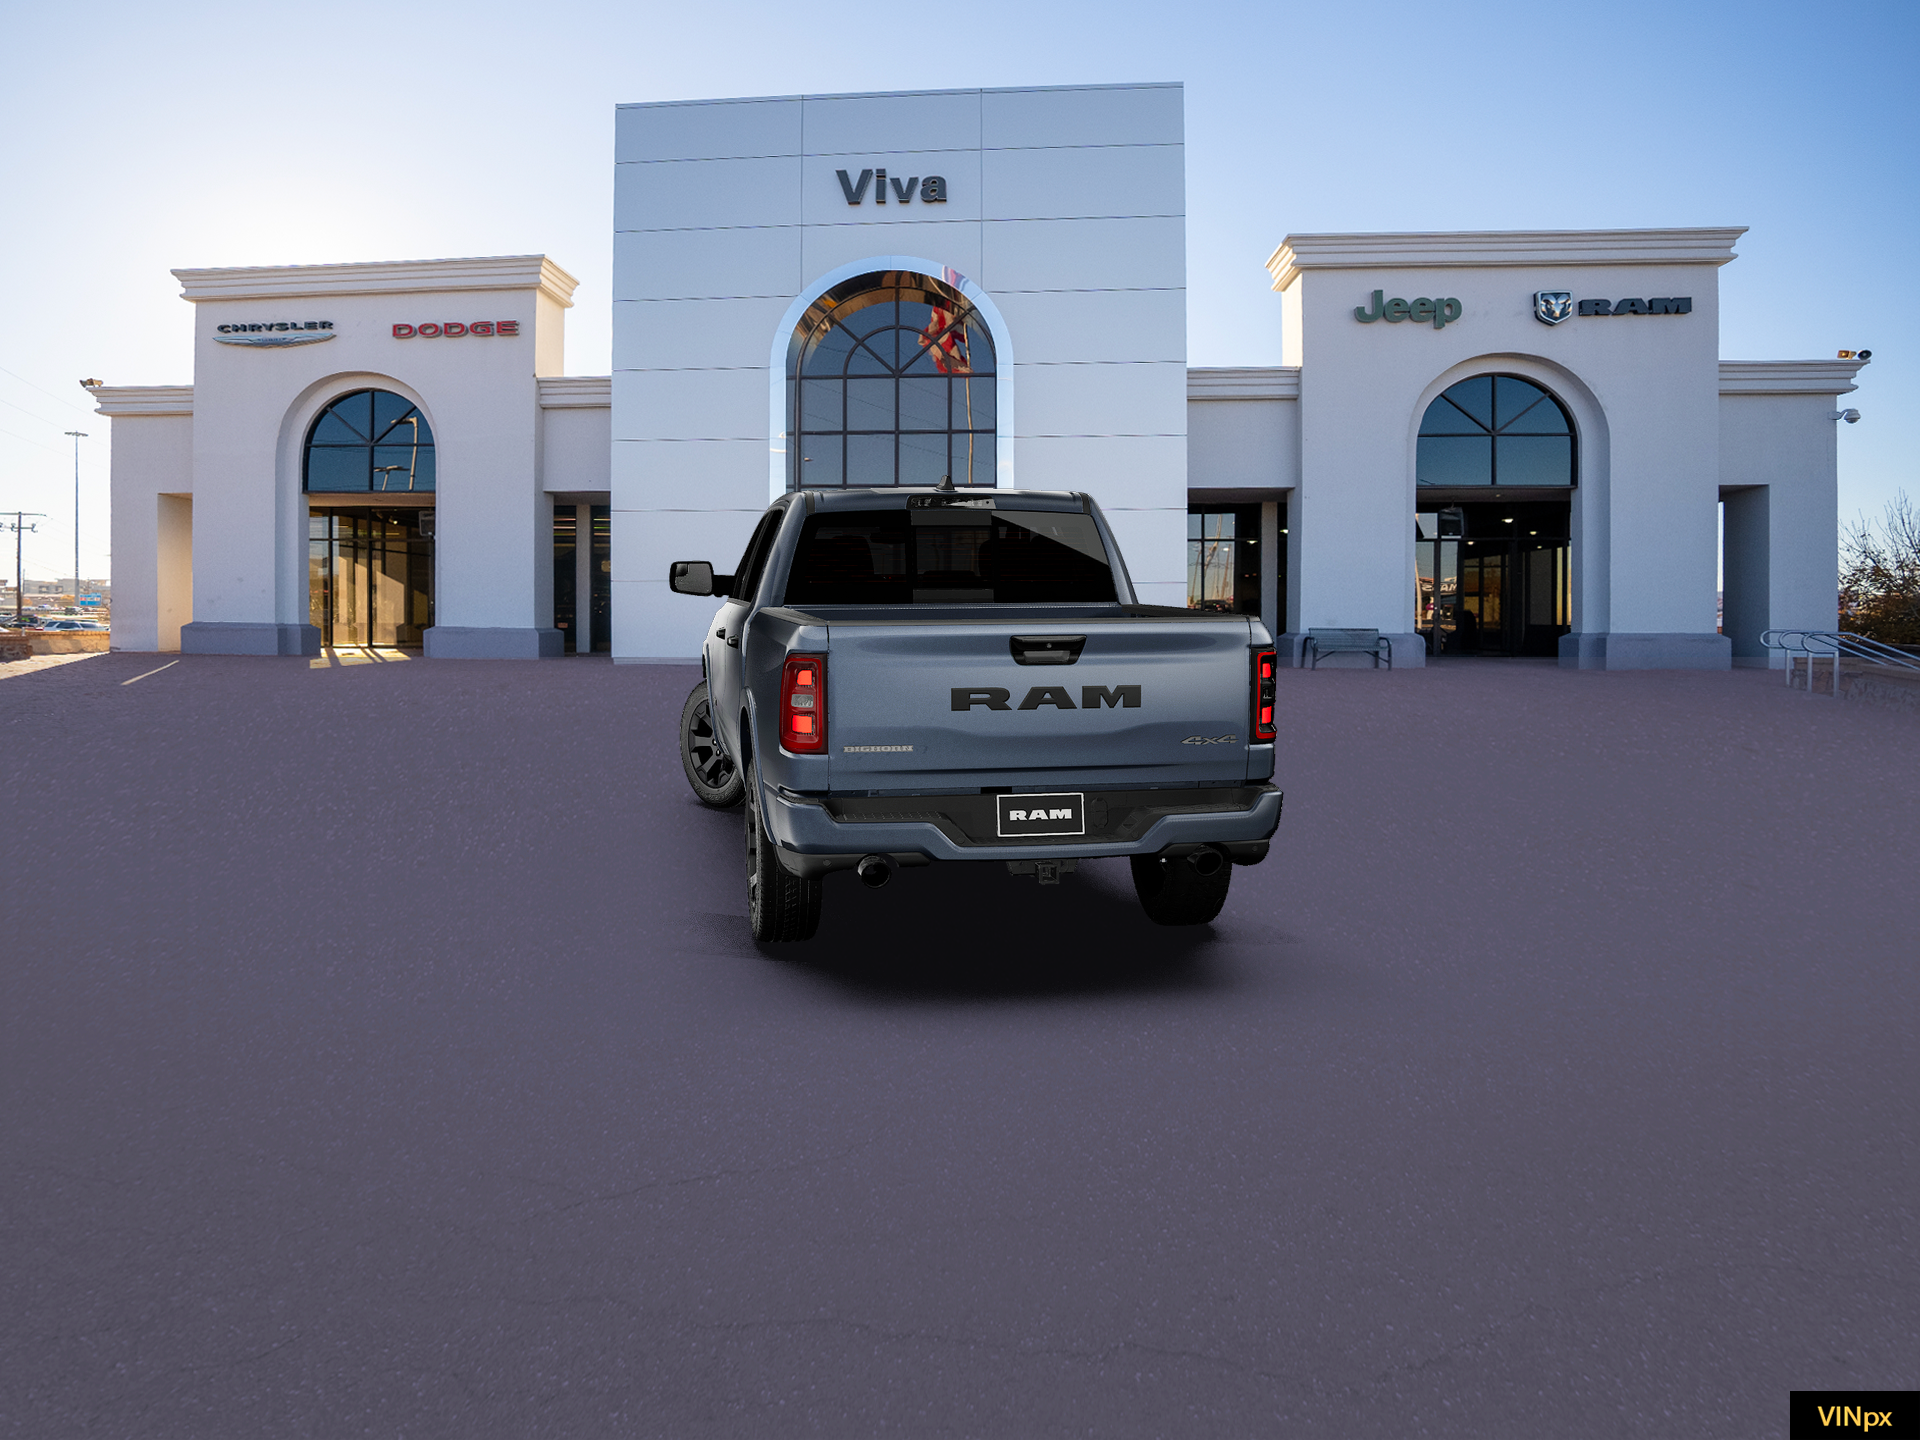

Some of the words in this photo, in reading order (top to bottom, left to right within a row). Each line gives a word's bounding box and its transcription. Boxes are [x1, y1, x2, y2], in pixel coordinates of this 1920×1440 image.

[835, 168, 947, 205] Viva
[1354, 289, 1463, 329] Jeep
[1578, 297, 1692, 316] RAM
[217, 320, 334, 333] CHRYSLER
[392, 320, 520, 338] DODGE
[951, 685, 1141, 711] RAM
[1180, 734, 1239, 745] 4x4
[843, 745, 914, 753] BIGHORN
[1009, 808, 1072, 821] RAM
